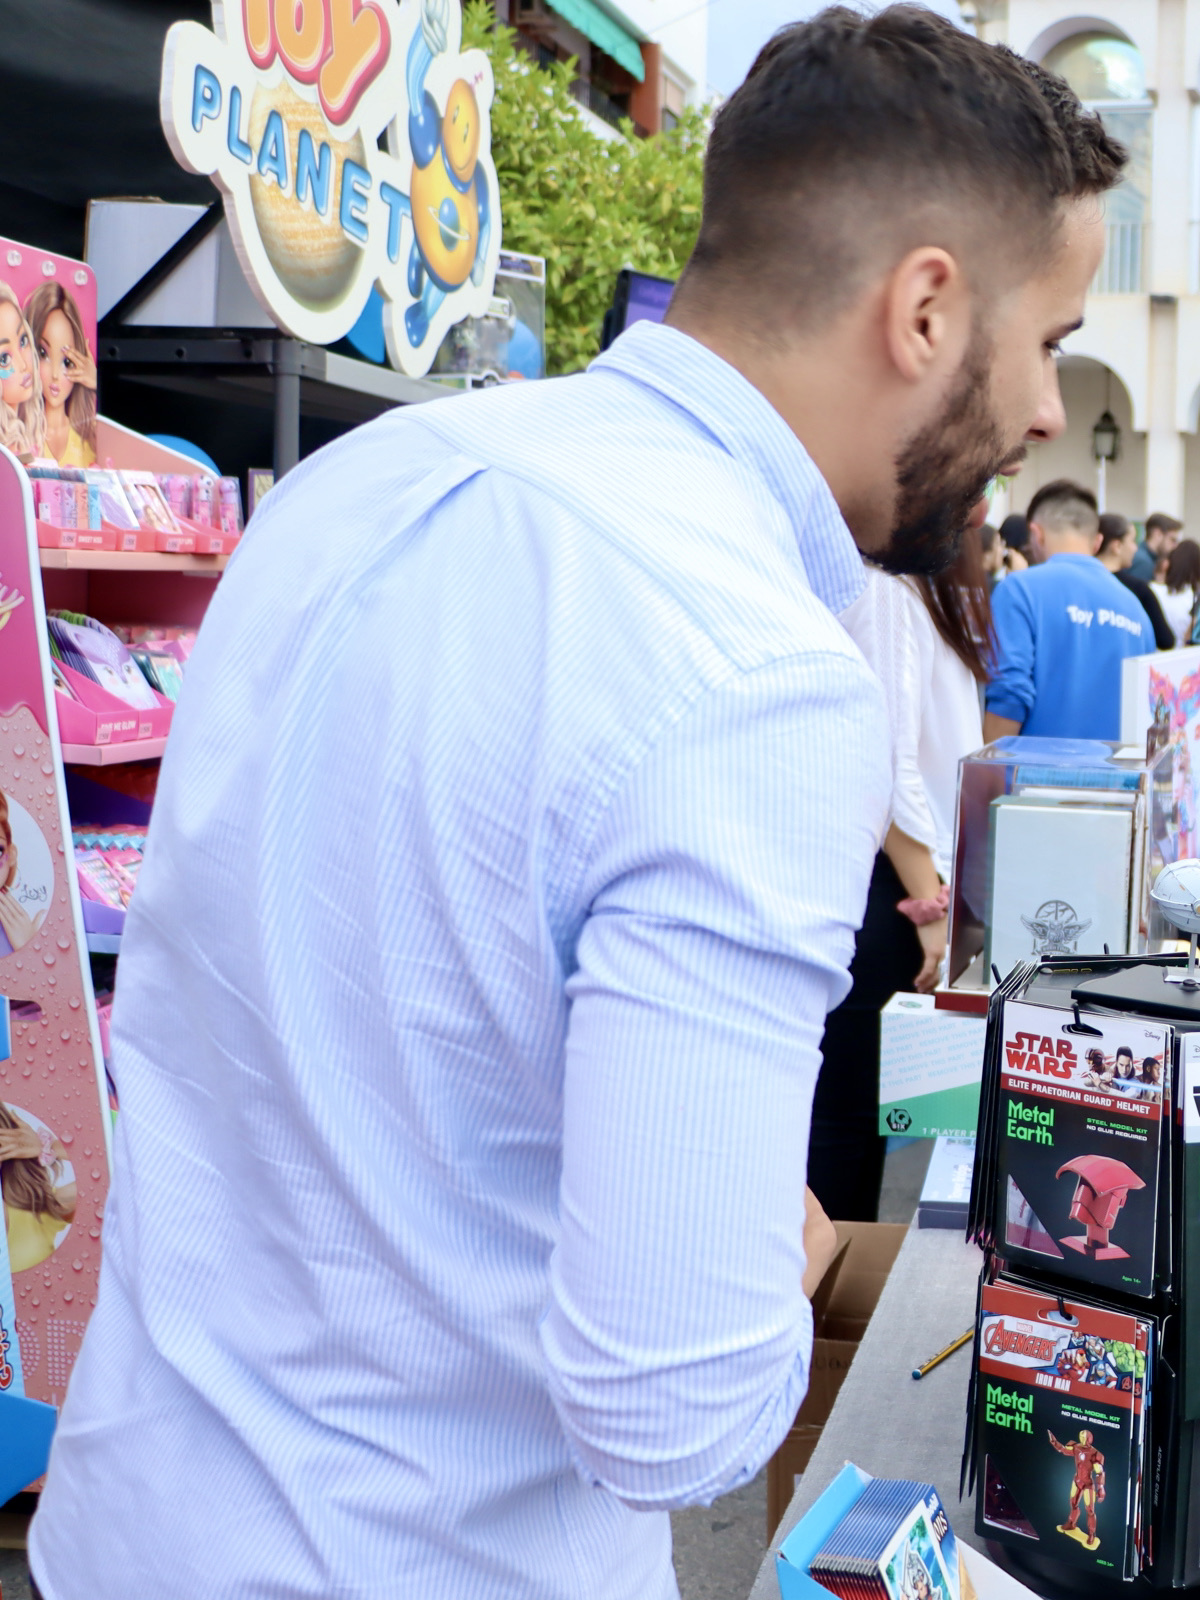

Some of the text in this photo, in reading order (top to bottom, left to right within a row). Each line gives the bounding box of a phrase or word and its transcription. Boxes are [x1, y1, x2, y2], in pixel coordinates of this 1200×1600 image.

[192, 64, 411, 264] PLANET
[1066, 605, 1094, 629] Toy
[1005, 1031, 1078, 1061] STAR
[1143, 1029, 1161, 1042] Disney
[1005, 1048, 1078, 1080] WARS
[1008, 1078, 1029, 1091] ELITE
[1031, 1083, 1081, 1101] PRAETORIAN
[1116, 1100, 1151, 1115] HELMET
[890, 1109, 910, 1124] IQ
[1008, 1099, 1055, 1127] Metal
[922, 1127, 927, 1135] 1
[930, 1128, 966, 1137] PLAYER
[1086, 1117, 1108, 1127] STEEL
[1109, 1122, 1134, 1132] MODEL
[1097, 1126, 1114, 1135] GLUE
[1115, 1130, 1148, 1142] REQUIRED
[984, 1319, 1057, 1361] AVENGERS
[1035, 1372, 1071, 1392] IRON MAN
[986, 1383, 1033, 1414] Metal
[1061, 1404, 1083, 1413] METAL
[1084, 1409, 1108, 1420] MODEL
[1071, 1413, 1088, 1421] GLUE
[1089, 1417, 1121, 1429] REQUIRED
